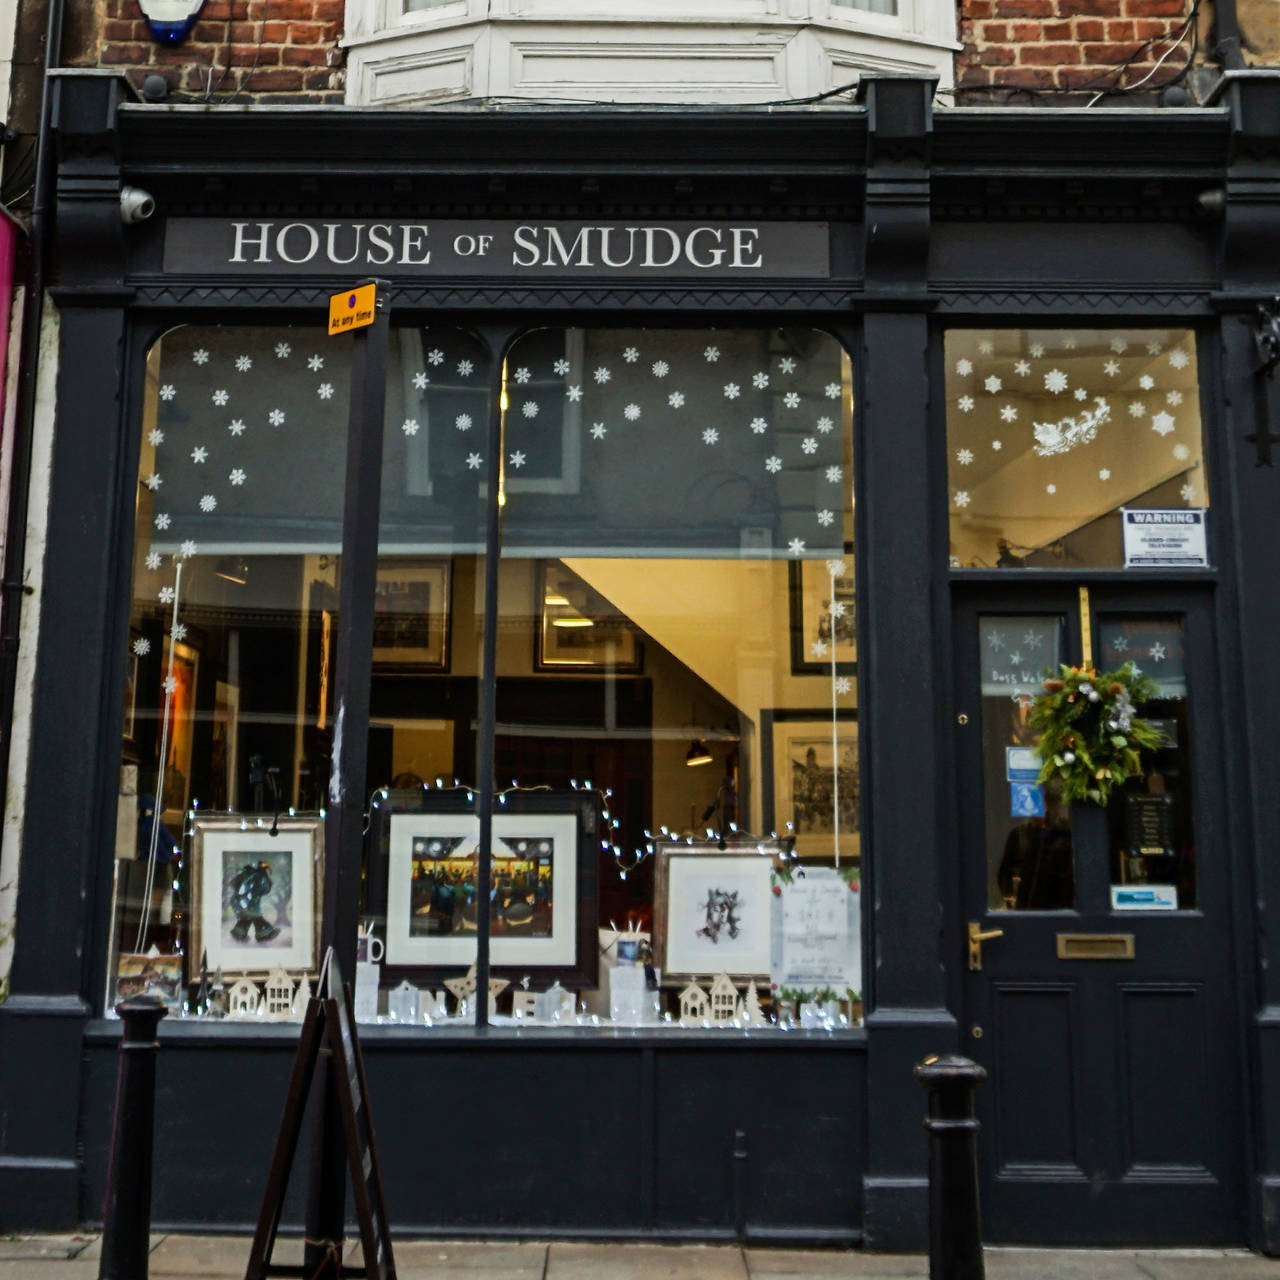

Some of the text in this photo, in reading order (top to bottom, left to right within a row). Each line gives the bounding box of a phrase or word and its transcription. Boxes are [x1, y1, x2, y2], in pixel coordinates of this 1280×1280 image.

[228, 221, 764, 270] HOUSE OF SMUDGE
[331, 310, 371, 328] At any time
[1133, 513, 1195, 524] WARNING
